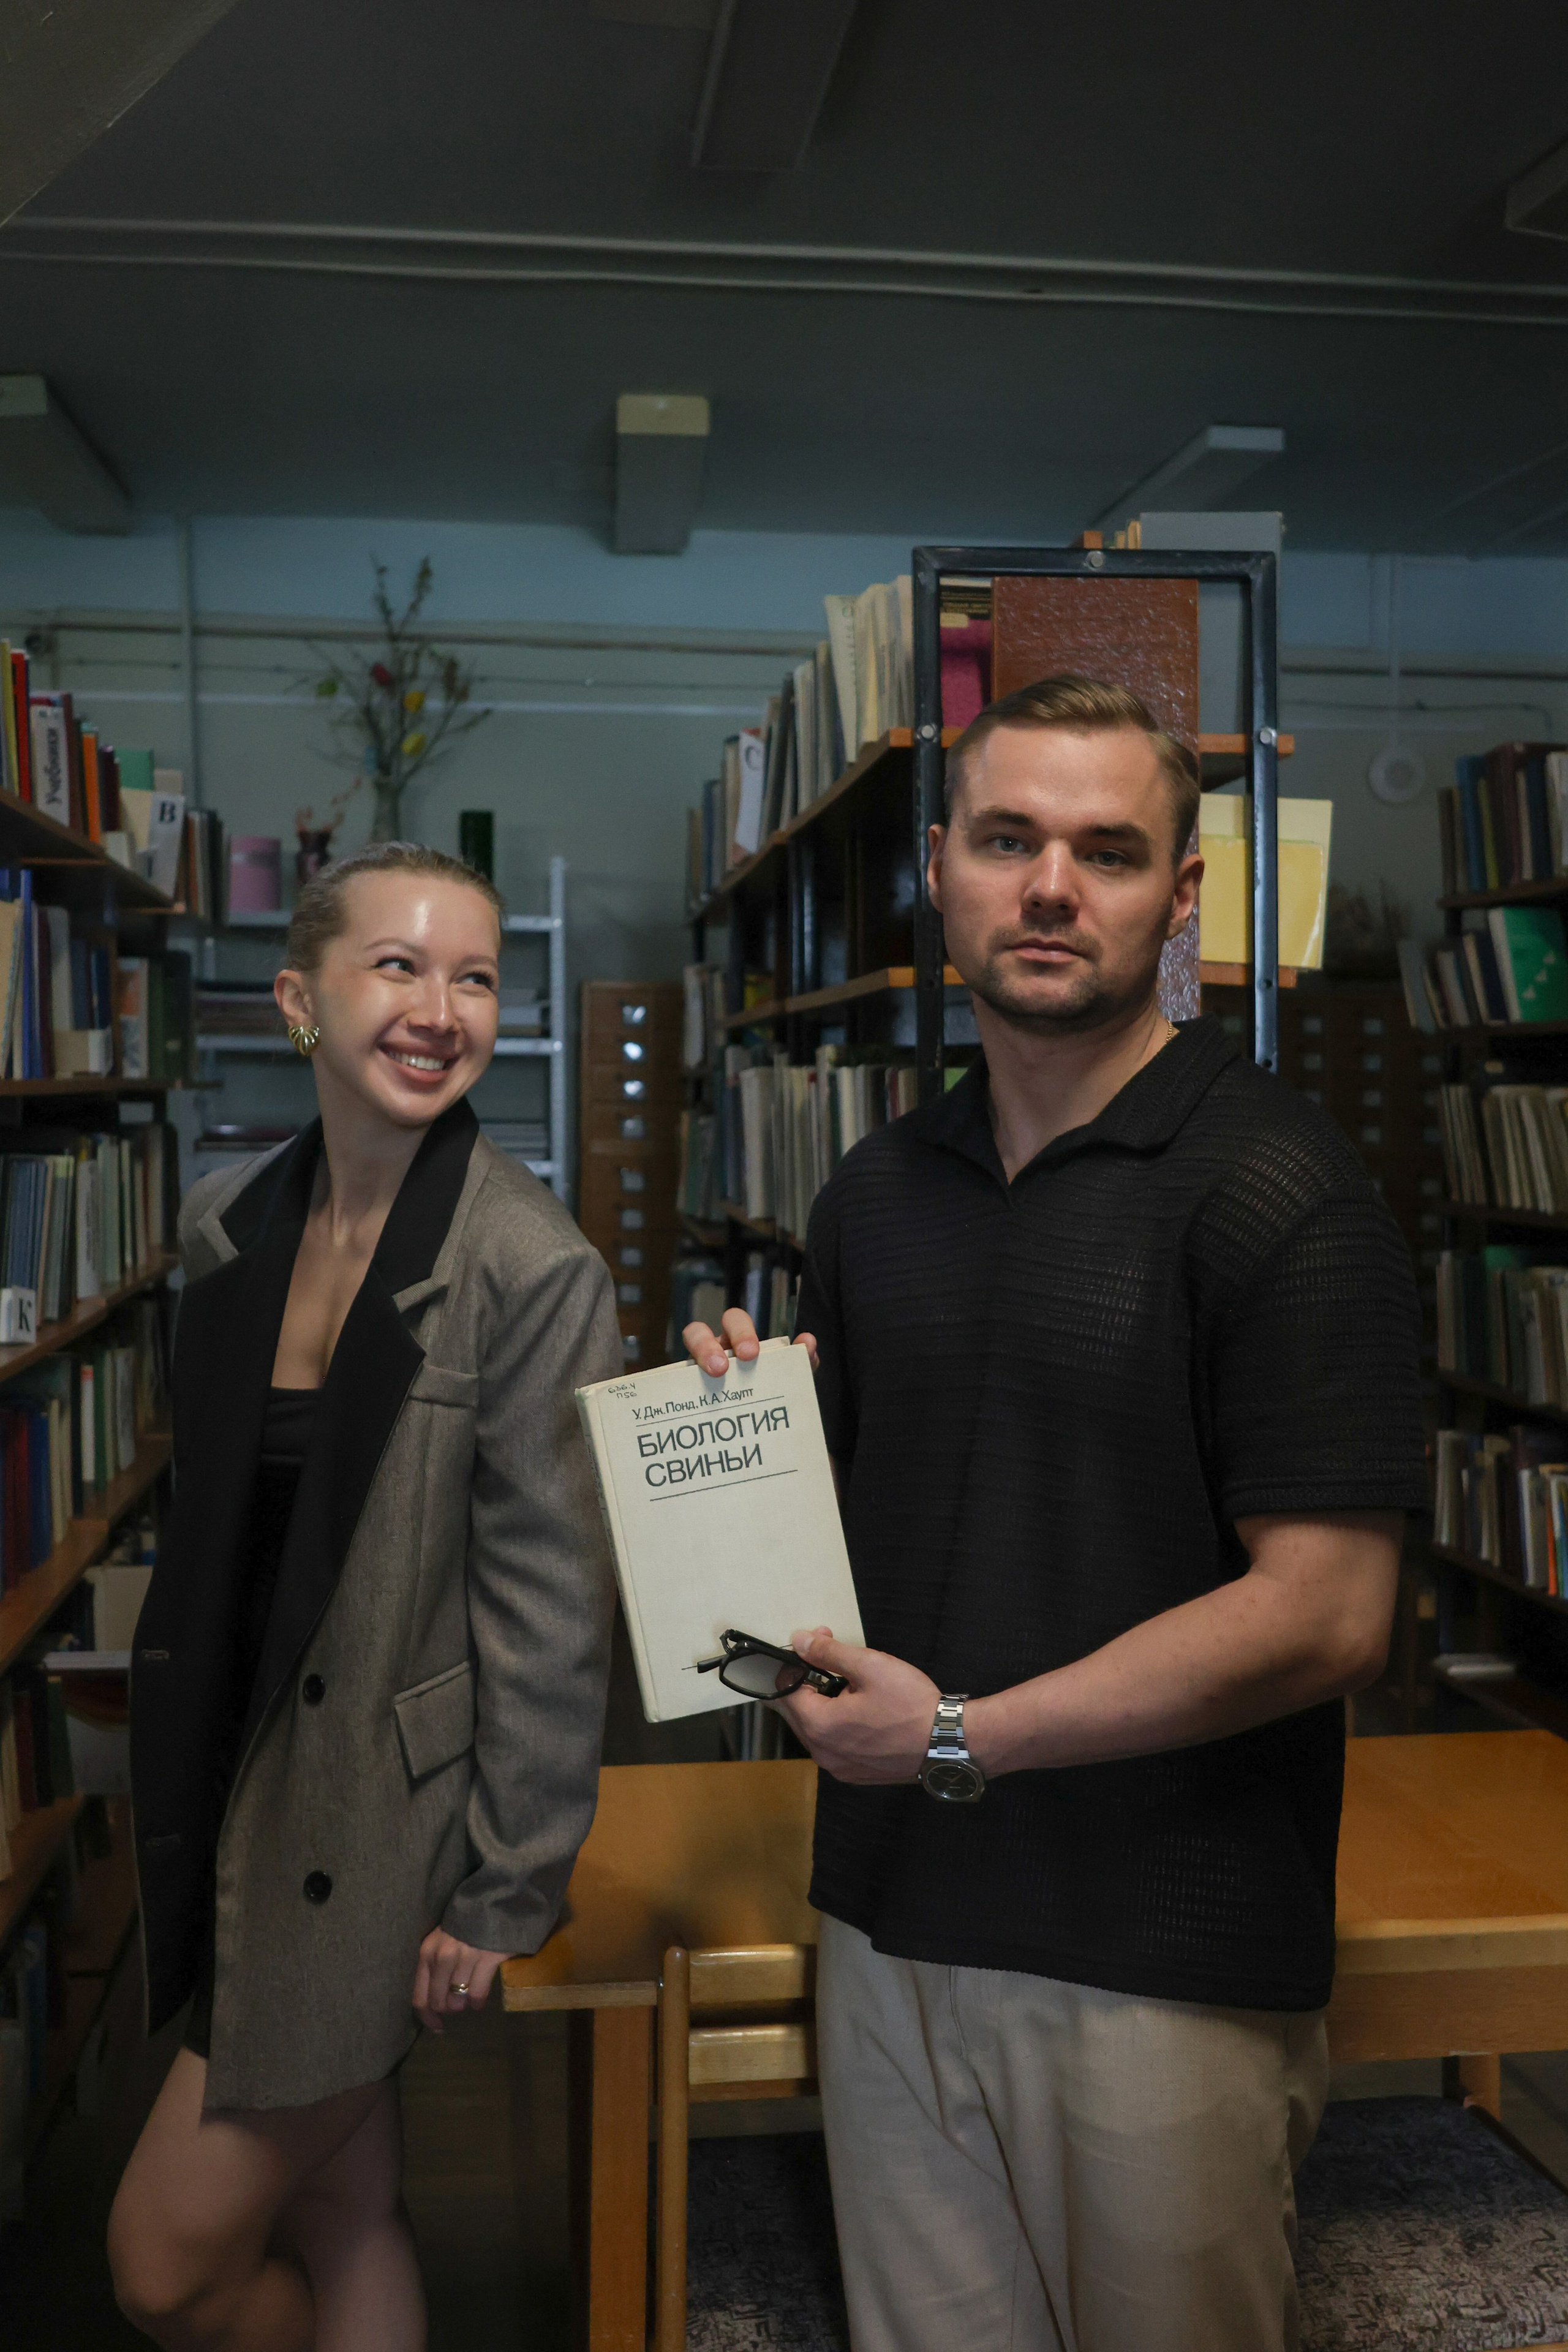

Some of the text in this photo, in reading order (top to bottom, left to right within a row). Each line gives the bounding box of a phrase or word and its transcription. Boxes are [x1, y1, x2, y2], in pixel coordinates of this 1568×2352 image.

[19, 1298, 32, 1332] К
[636, 1406, 790, 1458] БИОЛОГИЯ
[645, 1443, 763, 1487] СВИНЬИ
